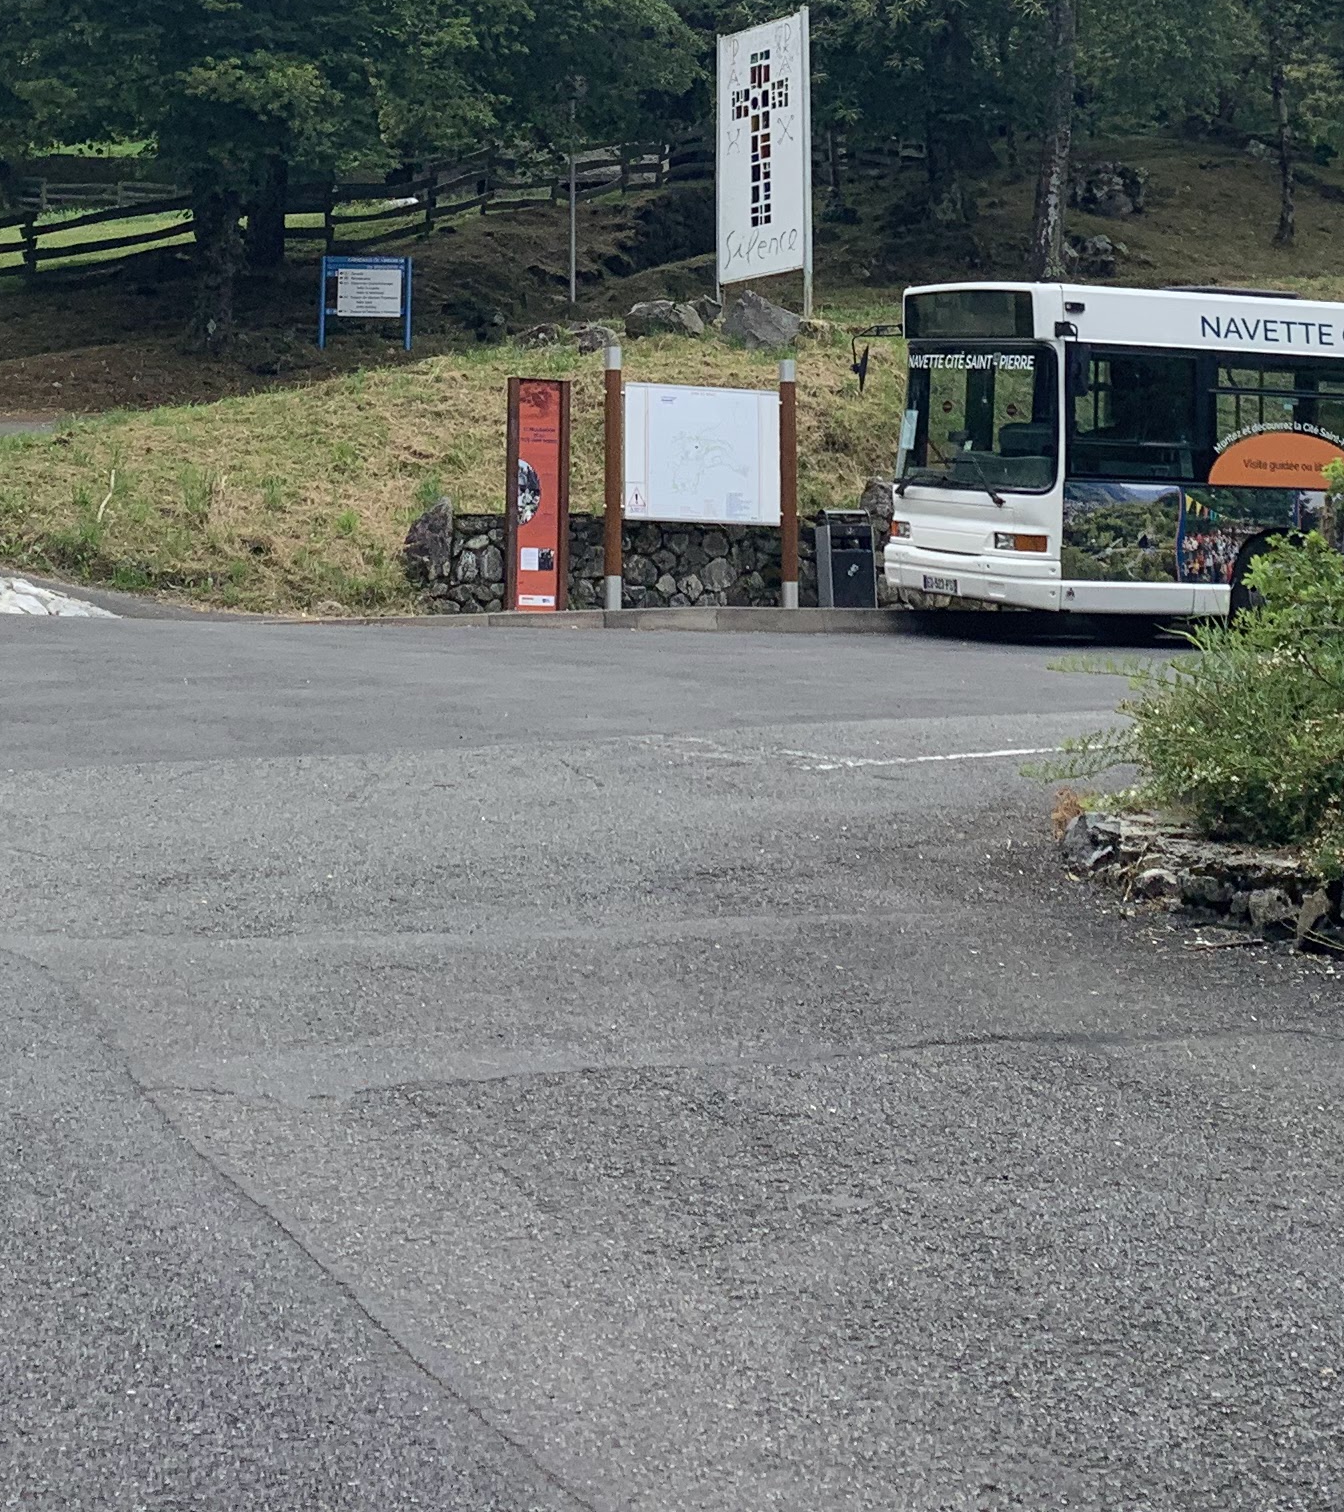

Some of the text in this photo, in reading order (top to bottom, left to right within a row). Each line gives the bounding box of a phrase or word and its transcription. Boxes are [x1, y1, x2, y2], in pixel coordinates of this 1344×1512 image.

[724, 228, 798, 270] Silence
[1200, 315, 1334, 346] NAVETTE
[909, 354, 945, 369] NAVETTE
[944, 351, 965, 369] CITÉ
[965, 354, 994, 370] SAINT
[999, 354, 1035, 370] PIERRE
[1213, 430, 1242, 454] Montez
[1243, 458, 1267, 470] Visite
